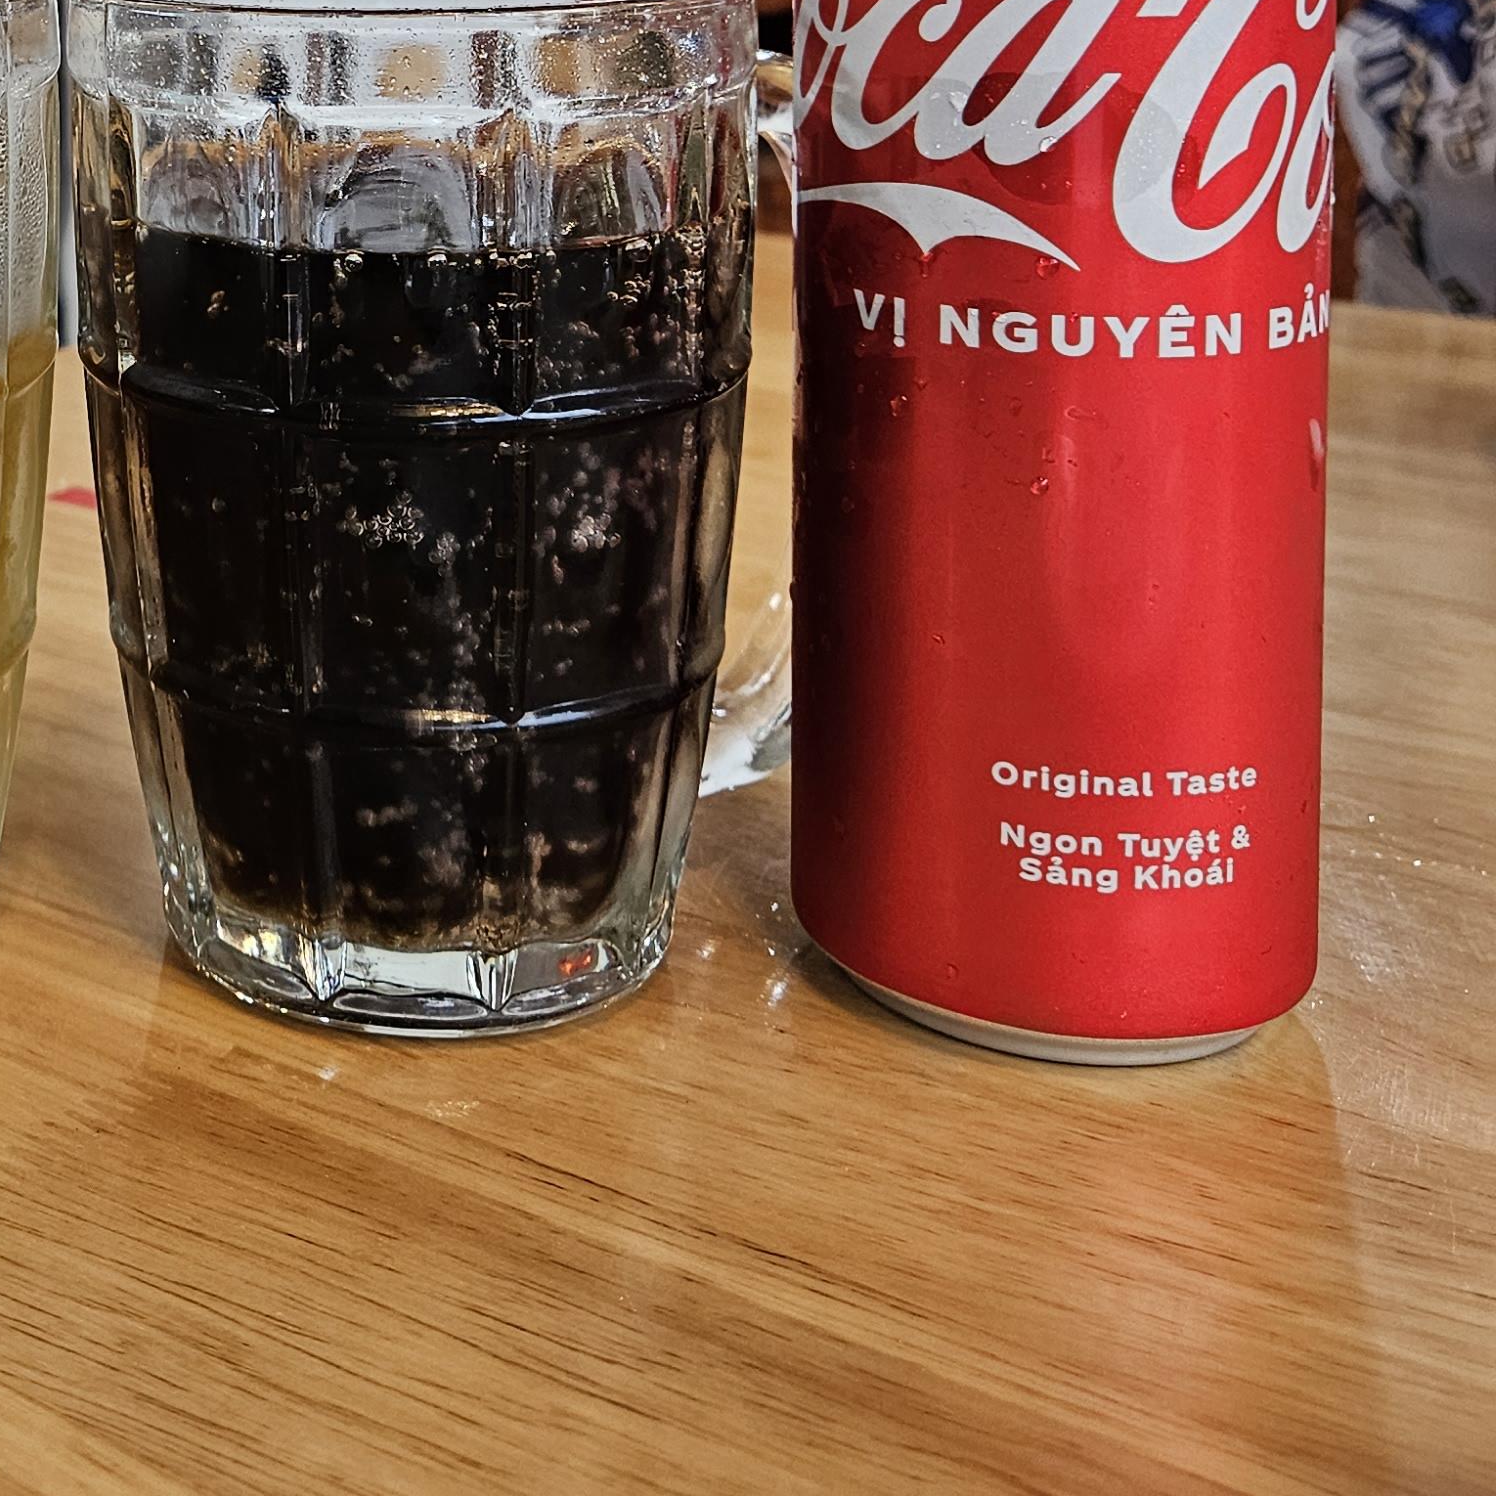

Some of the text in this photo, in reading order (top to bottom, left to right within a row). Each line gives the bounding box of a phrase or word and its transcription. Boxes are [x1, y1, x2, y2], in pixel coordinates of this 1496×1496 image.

[854, 289, 905, 346] VỊ
[938, 304, 1242, 358] NGUYÊN
[991, 761, 1258, 798] Original Taste
[999, 821, 1251, 861] Ngon Tuyệt &
[1018, 857, 1235, 894] Sảng Khoái
